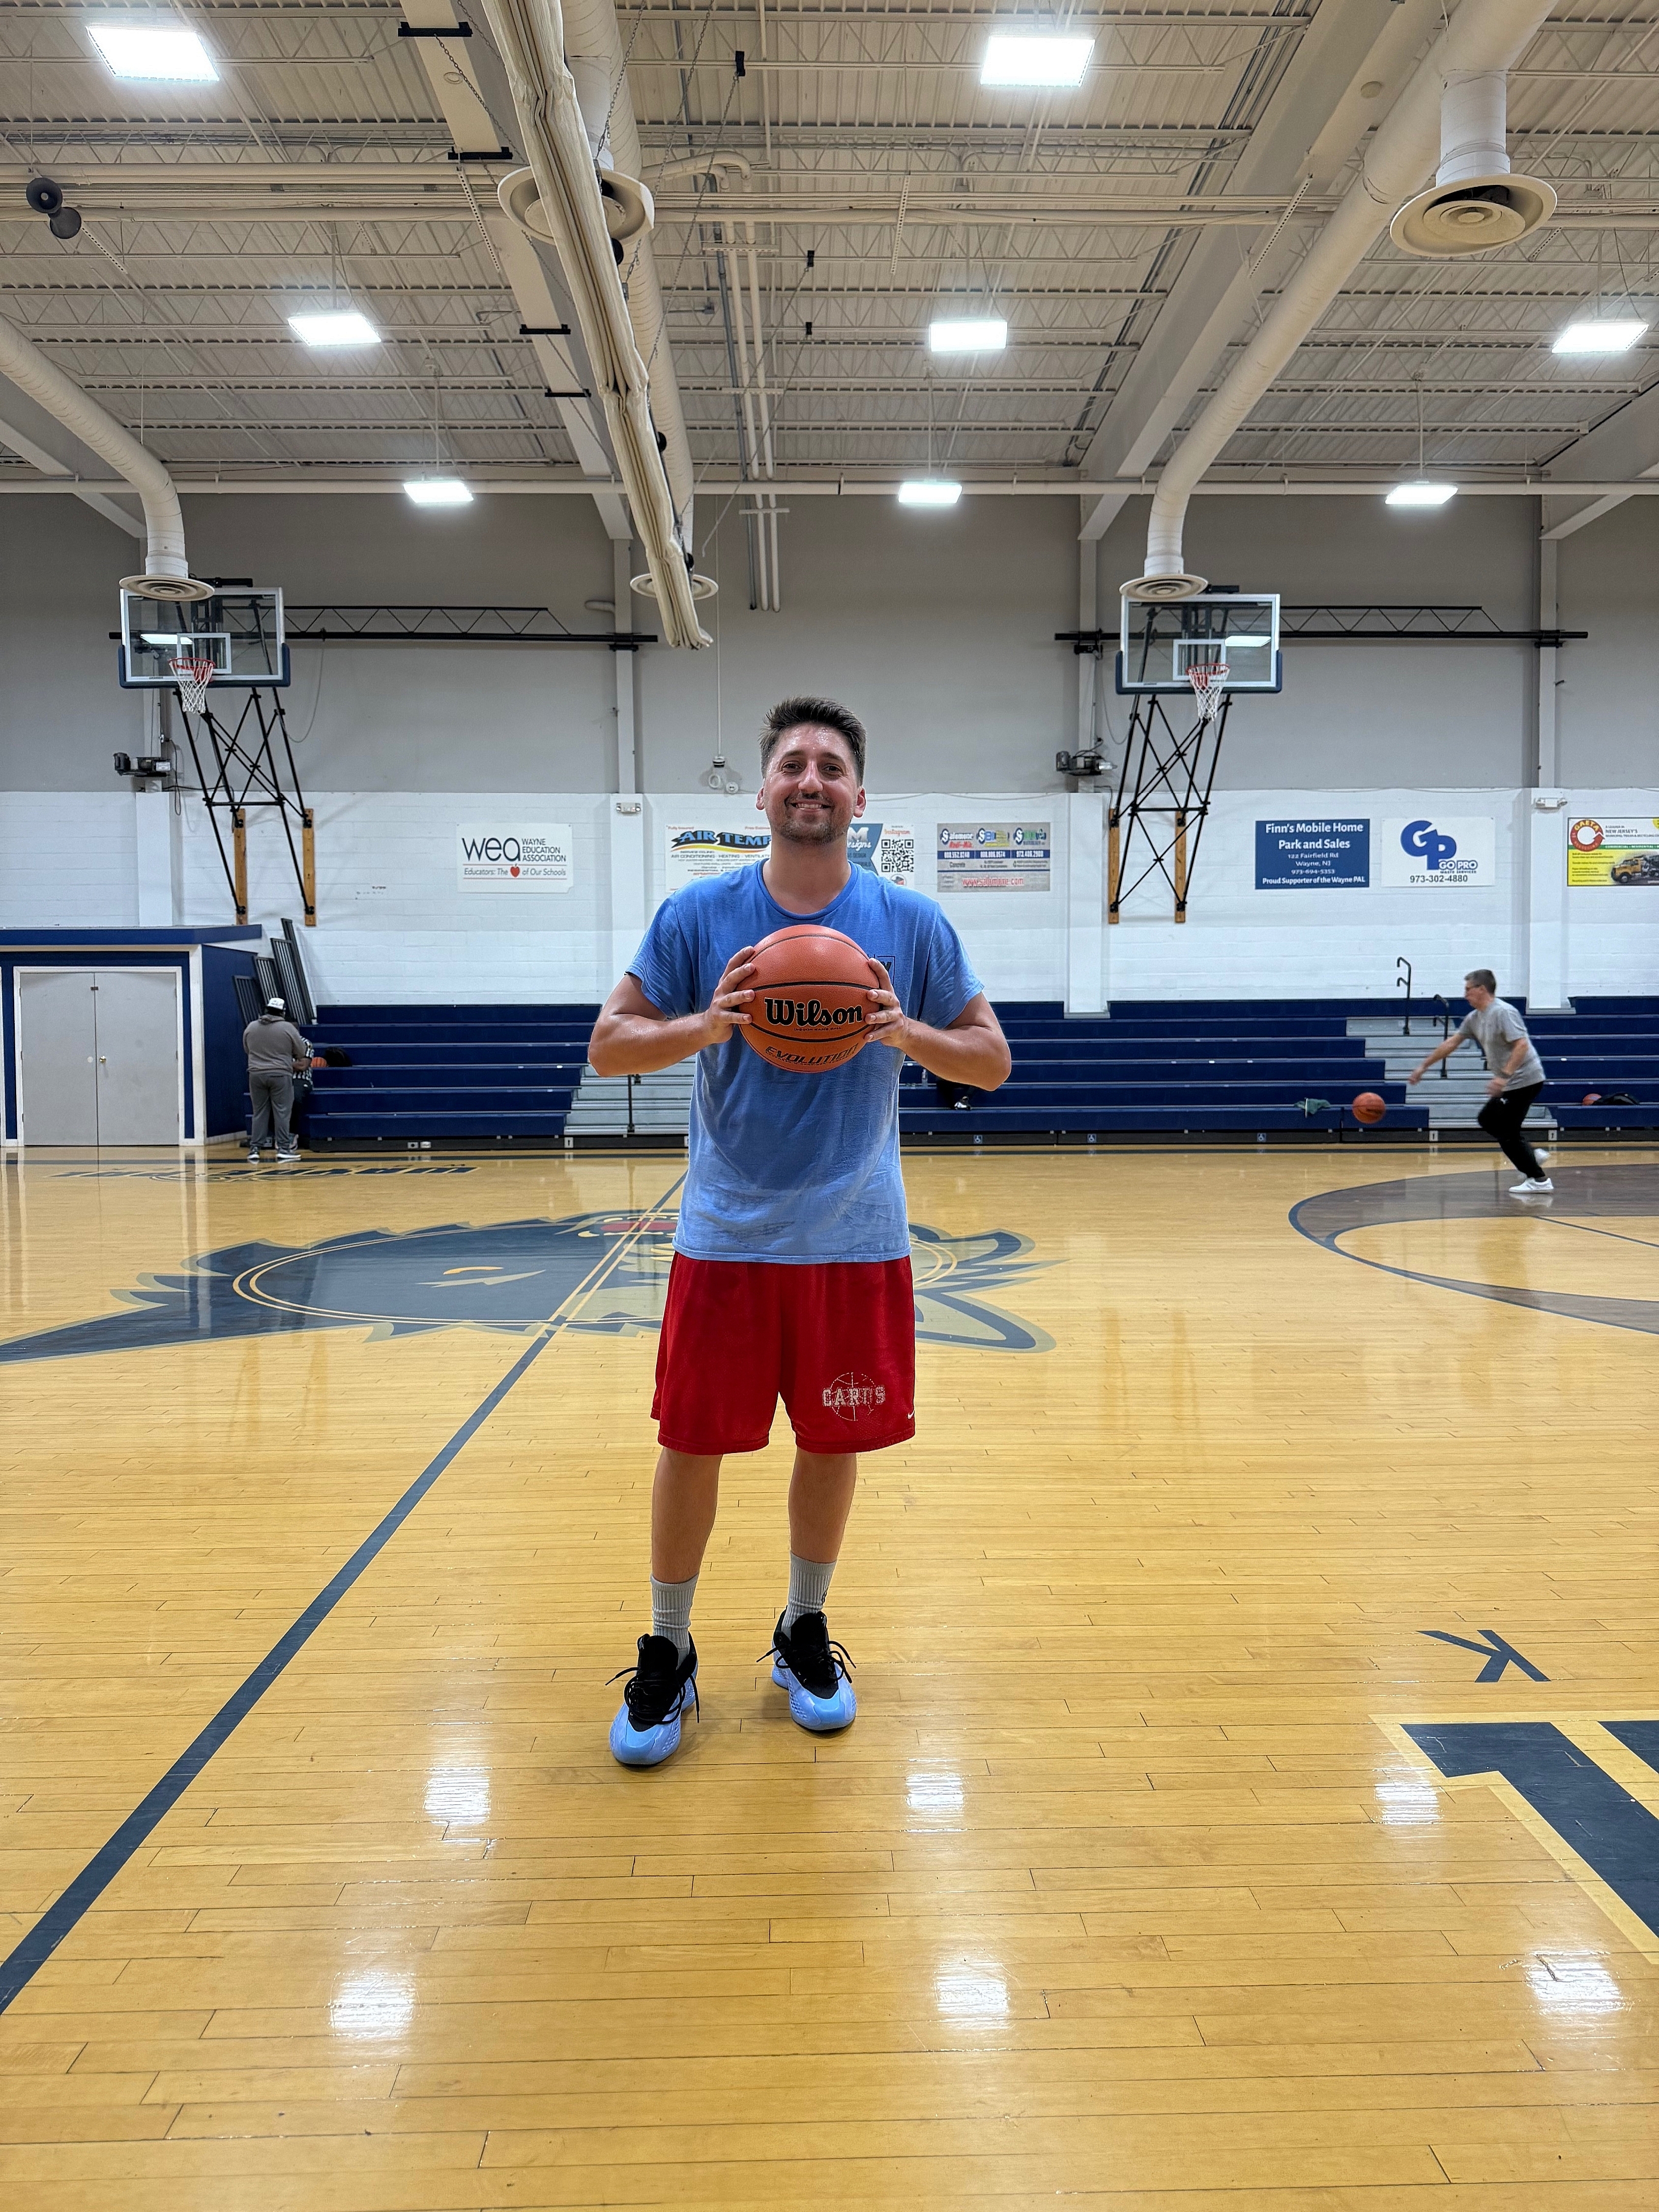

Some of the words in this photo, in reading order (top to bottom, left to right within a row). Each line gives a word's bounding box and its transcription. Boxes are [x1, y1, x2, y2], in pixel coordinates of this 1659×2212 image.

[1266, 823, 1294, 834] Finn's
[1296, 822, 1332, 833] Mobile
[1333, 822, 1364, 832] Home
[673, 830, 718, 845] AIR
[1279, 839, 1302, 849] Park
[1303, 839, 1322, 849] and
[1324, 838, 1351, 849] Sales
[462, 838, 521, 861] wea
[1439, 861, 1455, 870] GO
[1456, 860, 1478, 870] PRO
[1410, 874, 1468, 883] 973-302-4880
[764, 997, 863, 1027] Wilson
[765, 1043, 859, 1064] EVOLUTION
